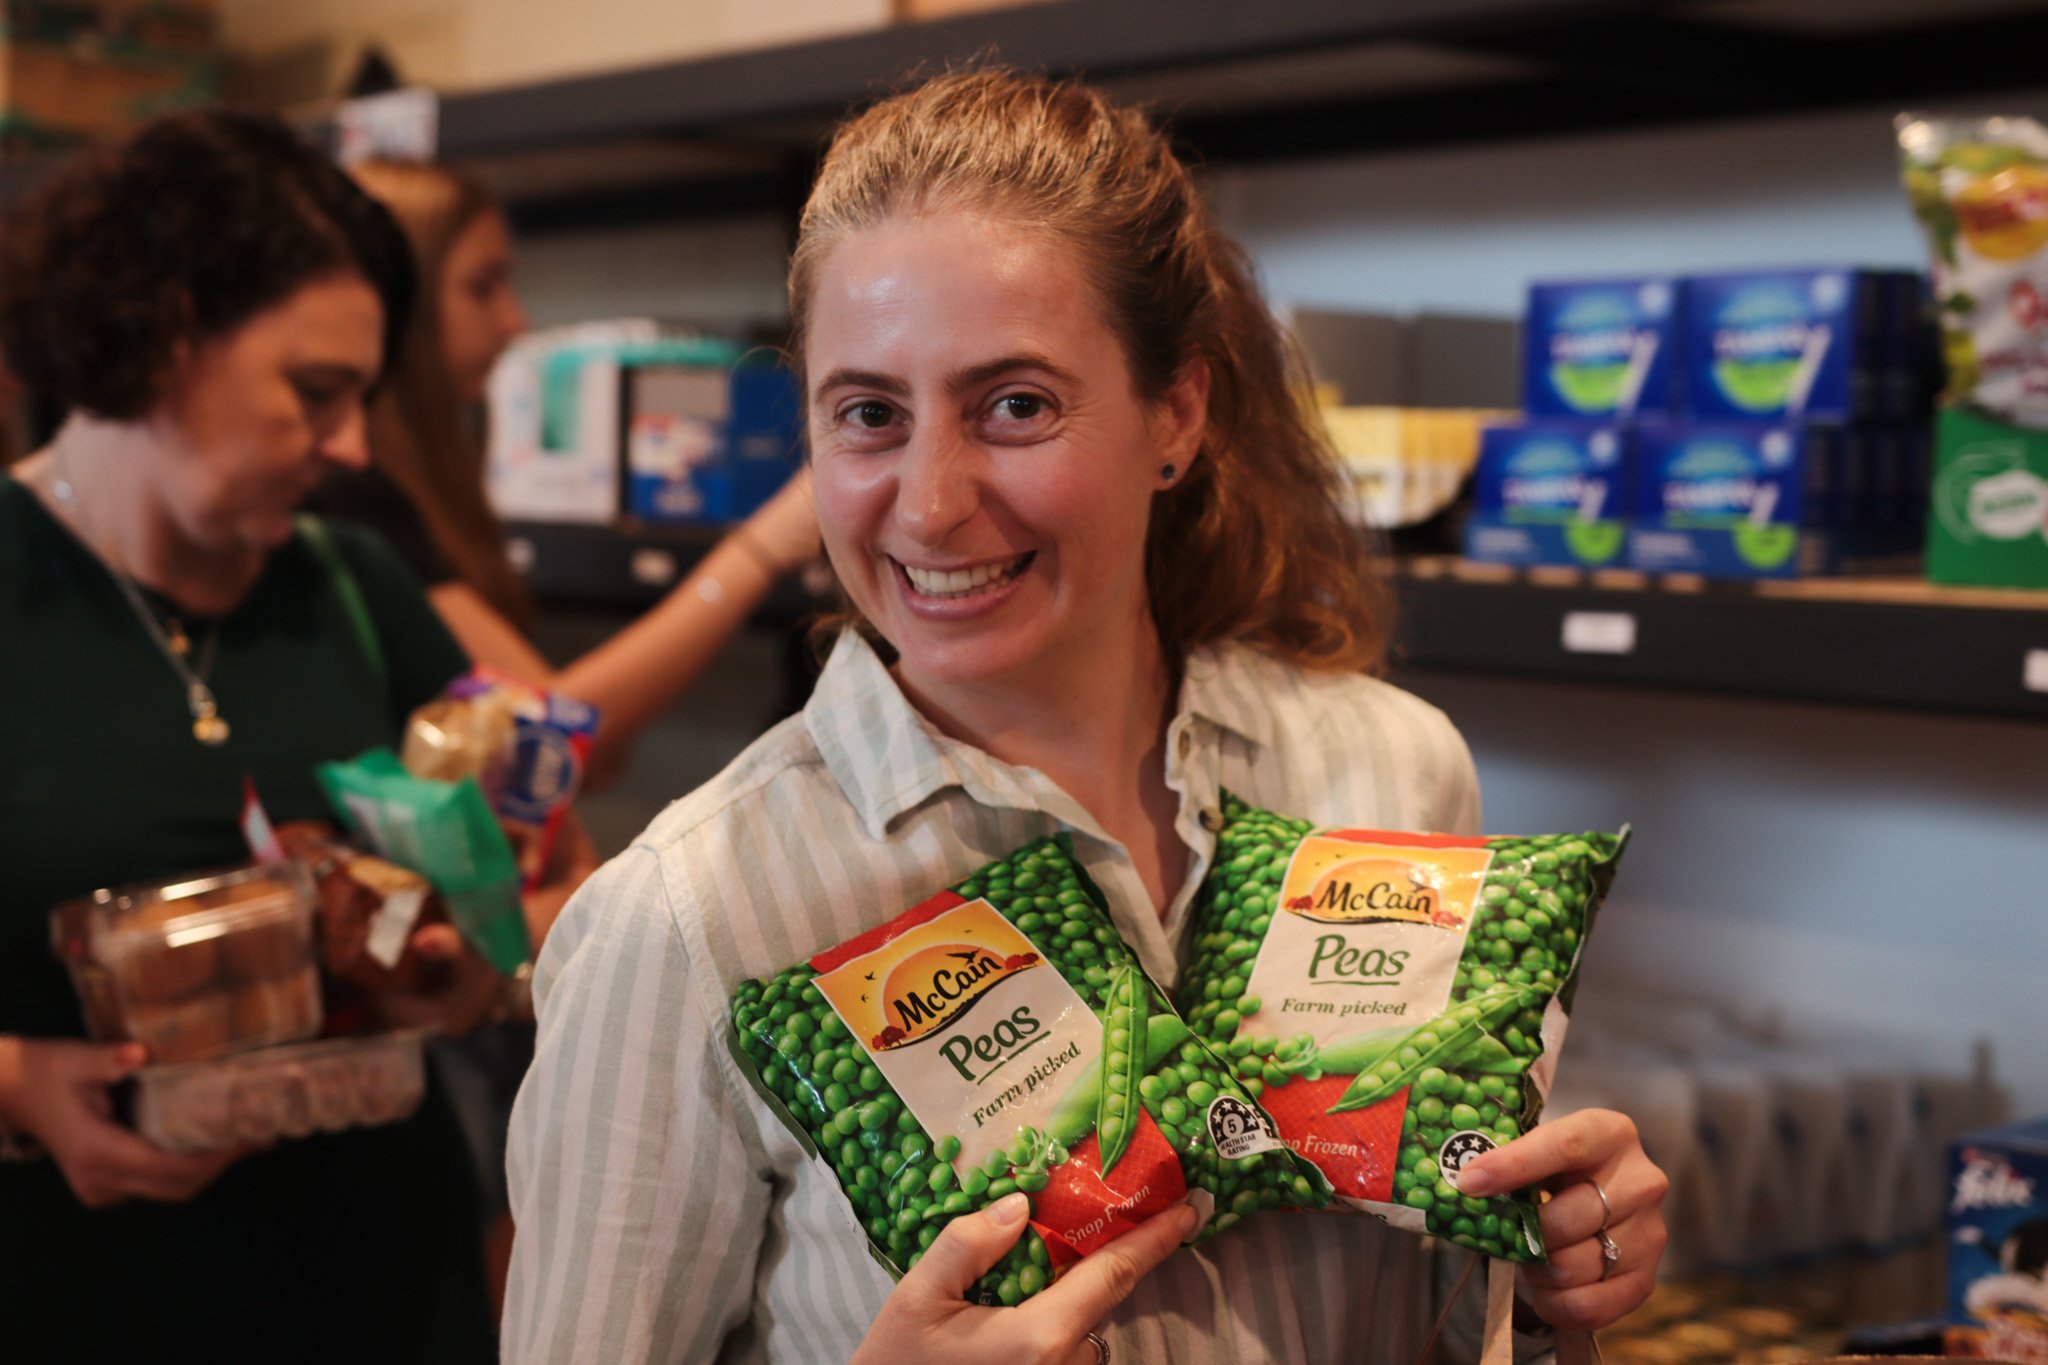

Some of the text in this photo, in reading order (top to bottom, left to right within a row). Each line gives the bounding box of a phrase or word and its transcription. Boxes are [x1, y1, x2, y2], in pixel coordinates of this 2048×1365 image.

[1316, 880, 1431, 914] McCain
[1308, 934, 1410, 979] Peas
[893, 956, 1003, 1032] McCain
[1281, 998, 1407, 1017] Farm picked
[939, 1006, 1041, 1082] Peas
[972, 1041, 1081, 1128] Farm picked
[1227, 1118, 1237, 1134] 5
[1240, 1133, 1256, 1144] STAR
[1227, 1143, 1249, 1156] RATING
[1284, 1132, 1358, 1157] ap Frozen
[1064, 1218, 1104, 1245] Snap
